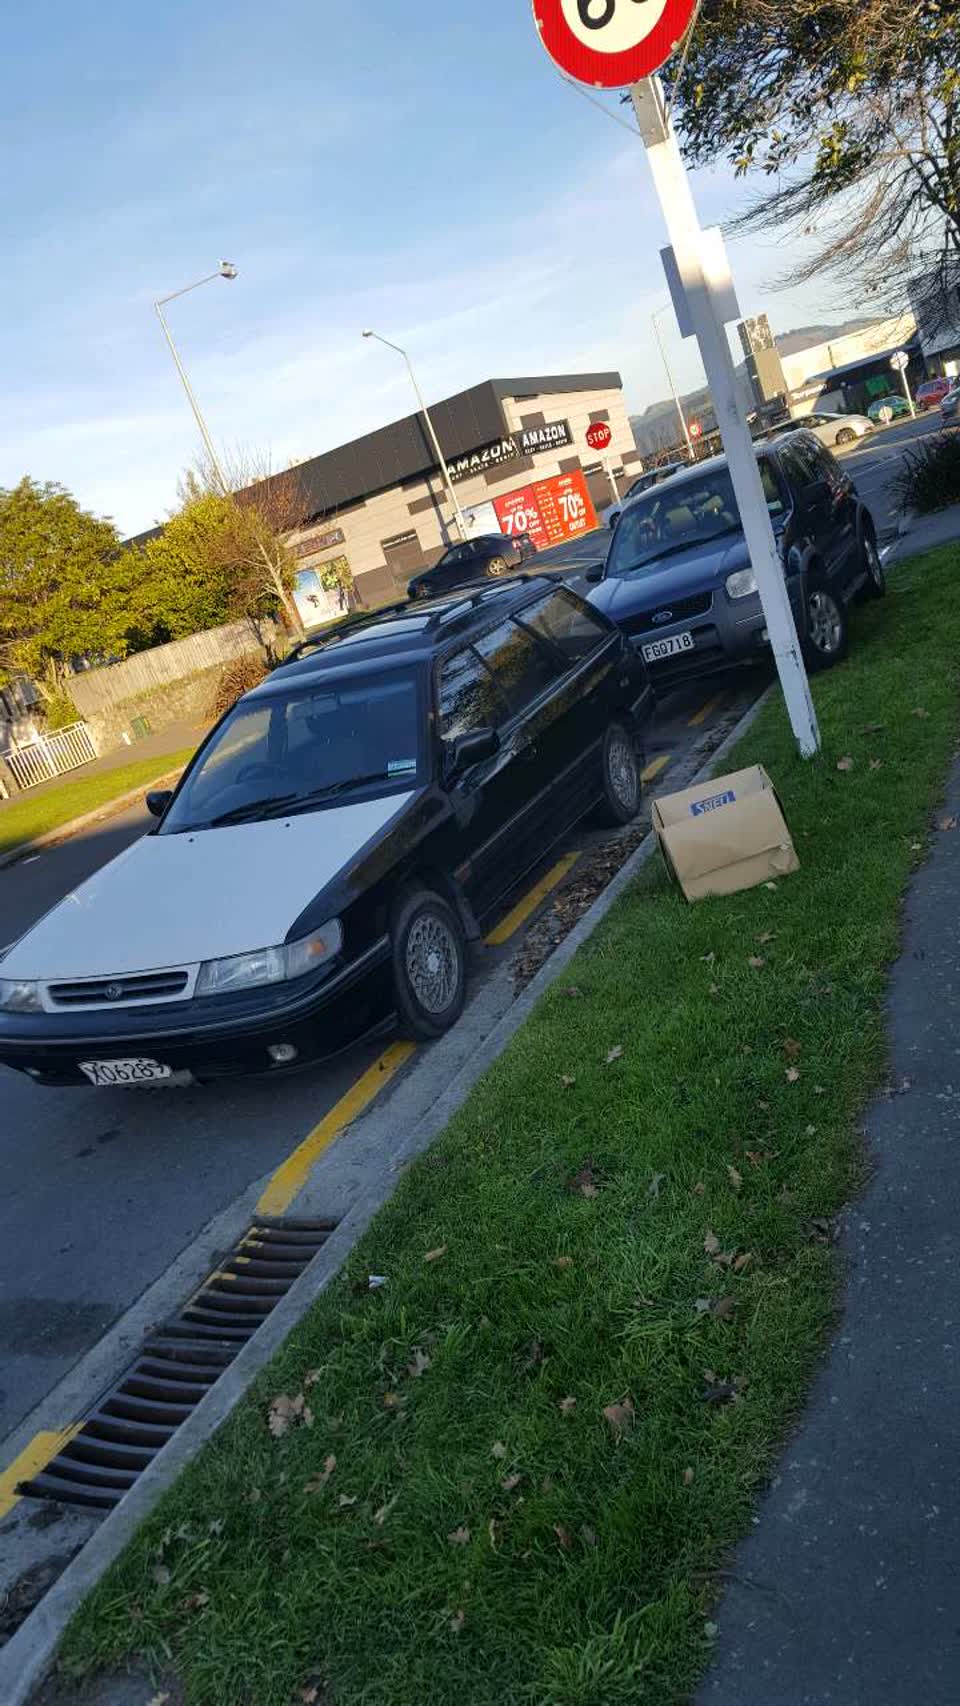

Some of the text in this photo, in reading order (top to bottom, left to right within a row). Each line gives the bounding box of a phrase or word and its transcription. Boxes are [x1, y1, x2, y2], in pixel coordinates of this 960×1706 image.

[522, 423, 566, 448] AMAZON
[587, 428, 610, 446] STOP
[447, 440, 514, 476] AMAZON
[502, 507, 538, 535] 70%
[558, 493, 584, 522] 70%
